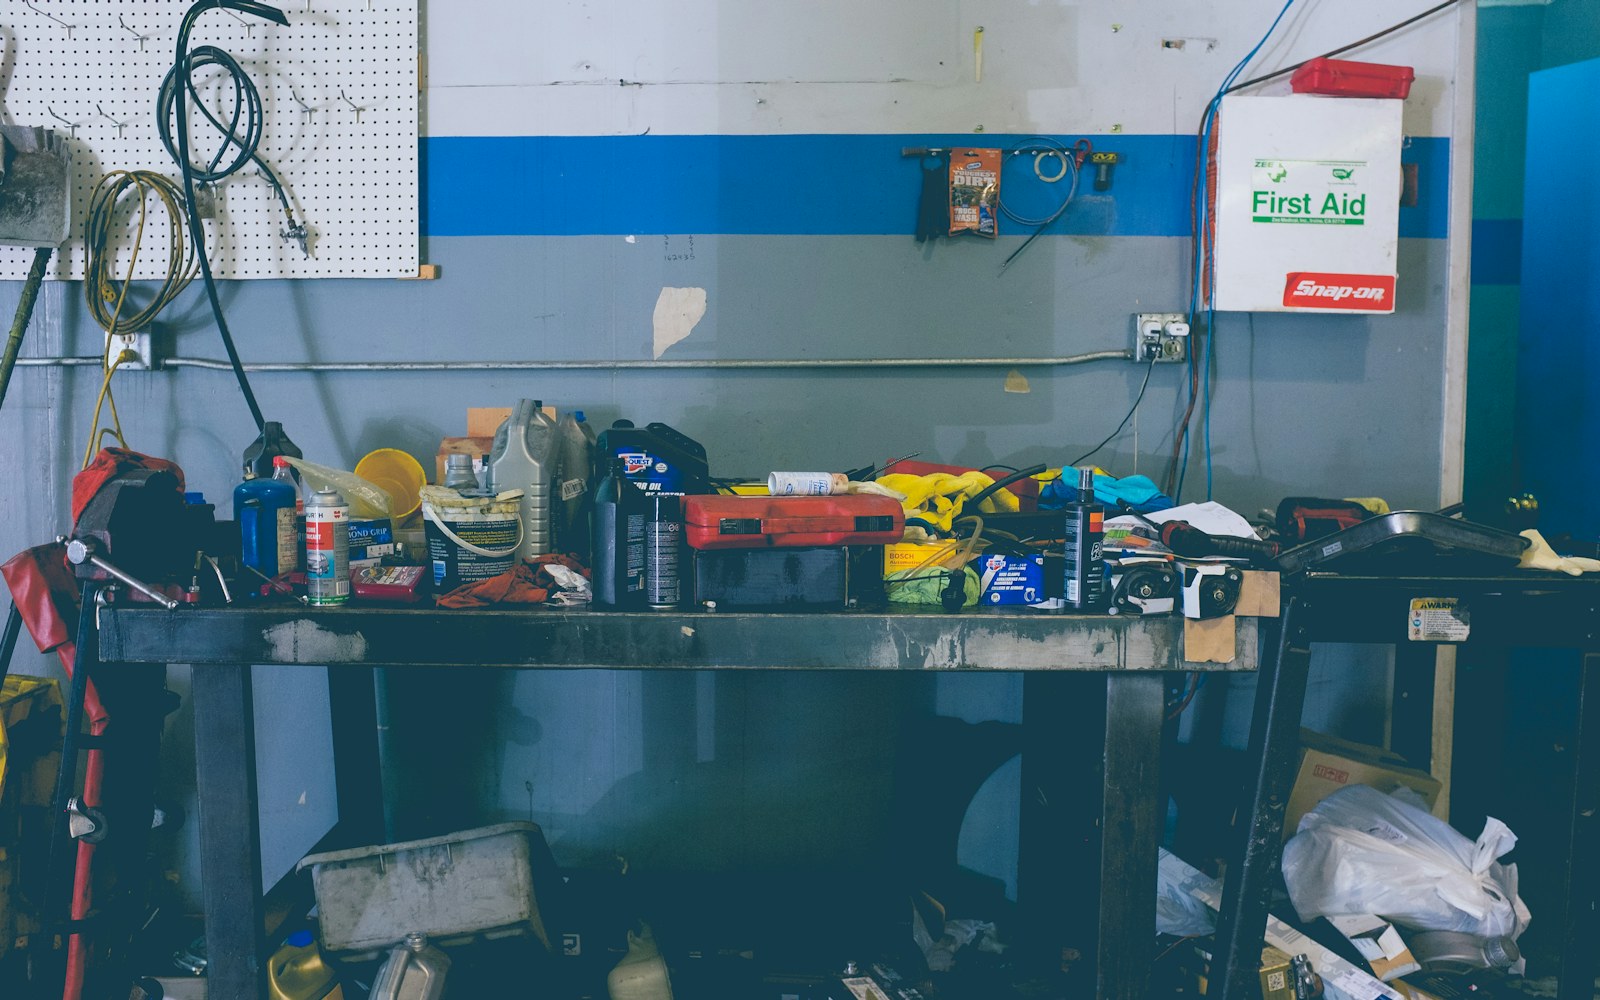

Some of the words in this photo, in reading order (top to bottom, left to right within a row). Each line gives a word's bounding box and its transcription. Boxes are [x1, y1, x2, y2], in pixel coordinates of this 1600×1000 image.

[954, 175, 996, 187] DIRT
[1252, 191, 1312, 215] First
[1320, 192, 1366, 216] Aid
[954, 214, 977, 222] WASH
[1292, 280, 1385, 301] Snap-on
[648, 482, 662, 490] OIL
[370, 528, 388, 536] GRIP
